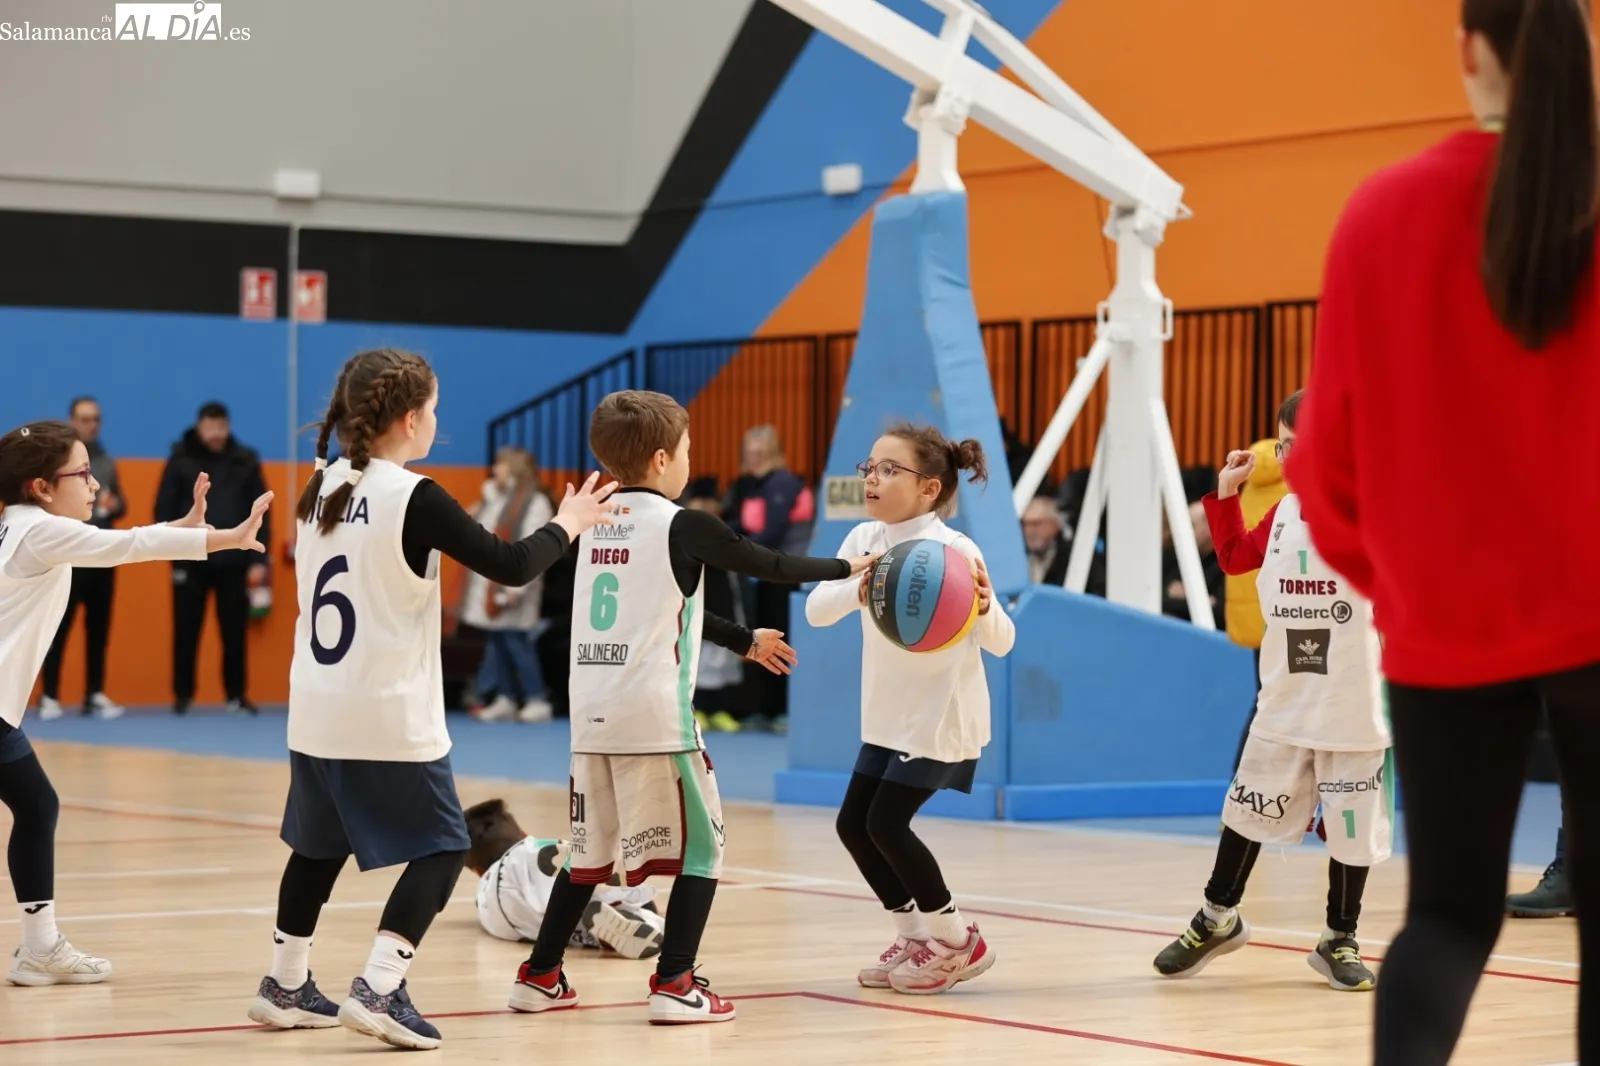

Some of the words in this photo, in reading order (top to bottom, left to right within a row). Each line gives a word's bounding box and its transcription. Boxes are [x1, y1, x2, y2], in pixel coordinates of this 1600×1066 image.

[591, 548, 630, 565] DIEGO
[1297, 550, 1308, 575] 1
[906, 550, 931, 619] molten
[1279, 578, 1337, 595] TORMES
[310, 554, 357, 666] 6
[589, 572, 619, 632] 6
[577, 643, 629, 661] SALINERO
[1317, 776, 1379, 793] codisoil
[1341, 809, 1356, 839] 1
[621, 826, 672, 850] CORPORE
[644, 838, 672, 852] HEALTH
